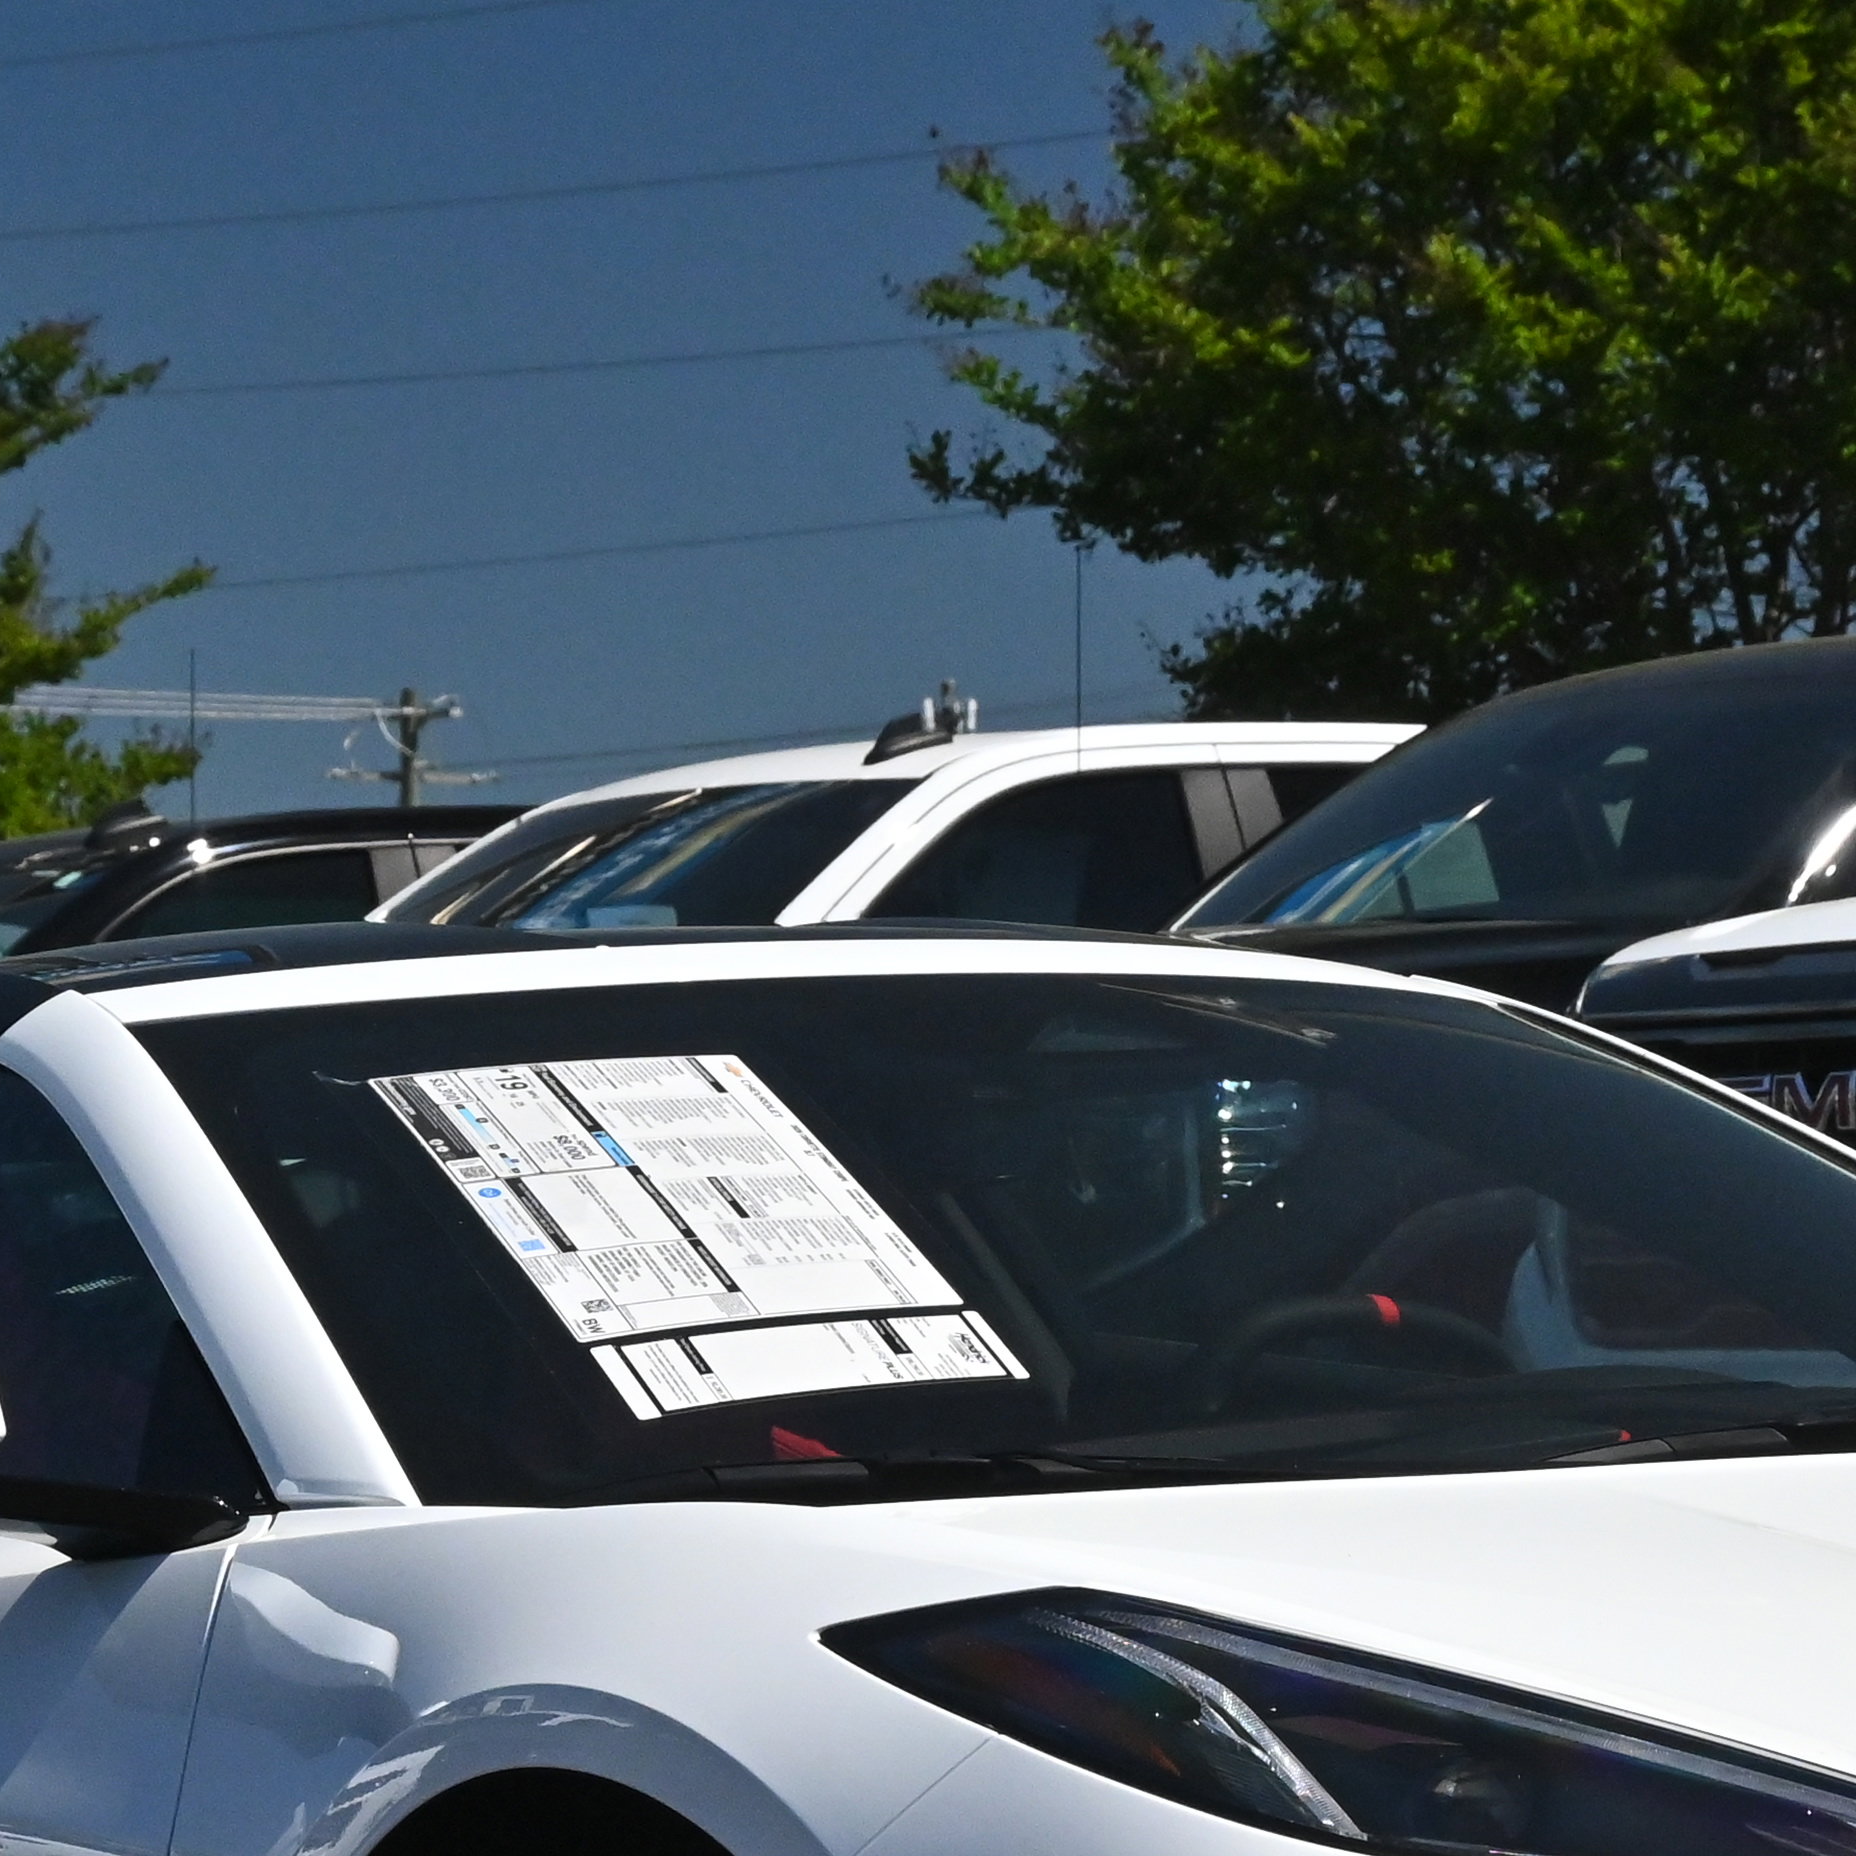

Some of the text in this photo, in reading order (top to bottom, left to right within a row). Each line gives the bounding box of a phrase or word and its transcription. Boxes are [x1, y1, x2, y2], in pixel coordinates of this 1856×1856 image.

[494, 1074, 528, 1091] 19
[740, 1080, 783, 1117] CHEVROLET
[552, 1134, 586, 1161] $8,000
[581, 1317, 605, 1334] BW
[882, 1360, 905, 1380] PLUS
